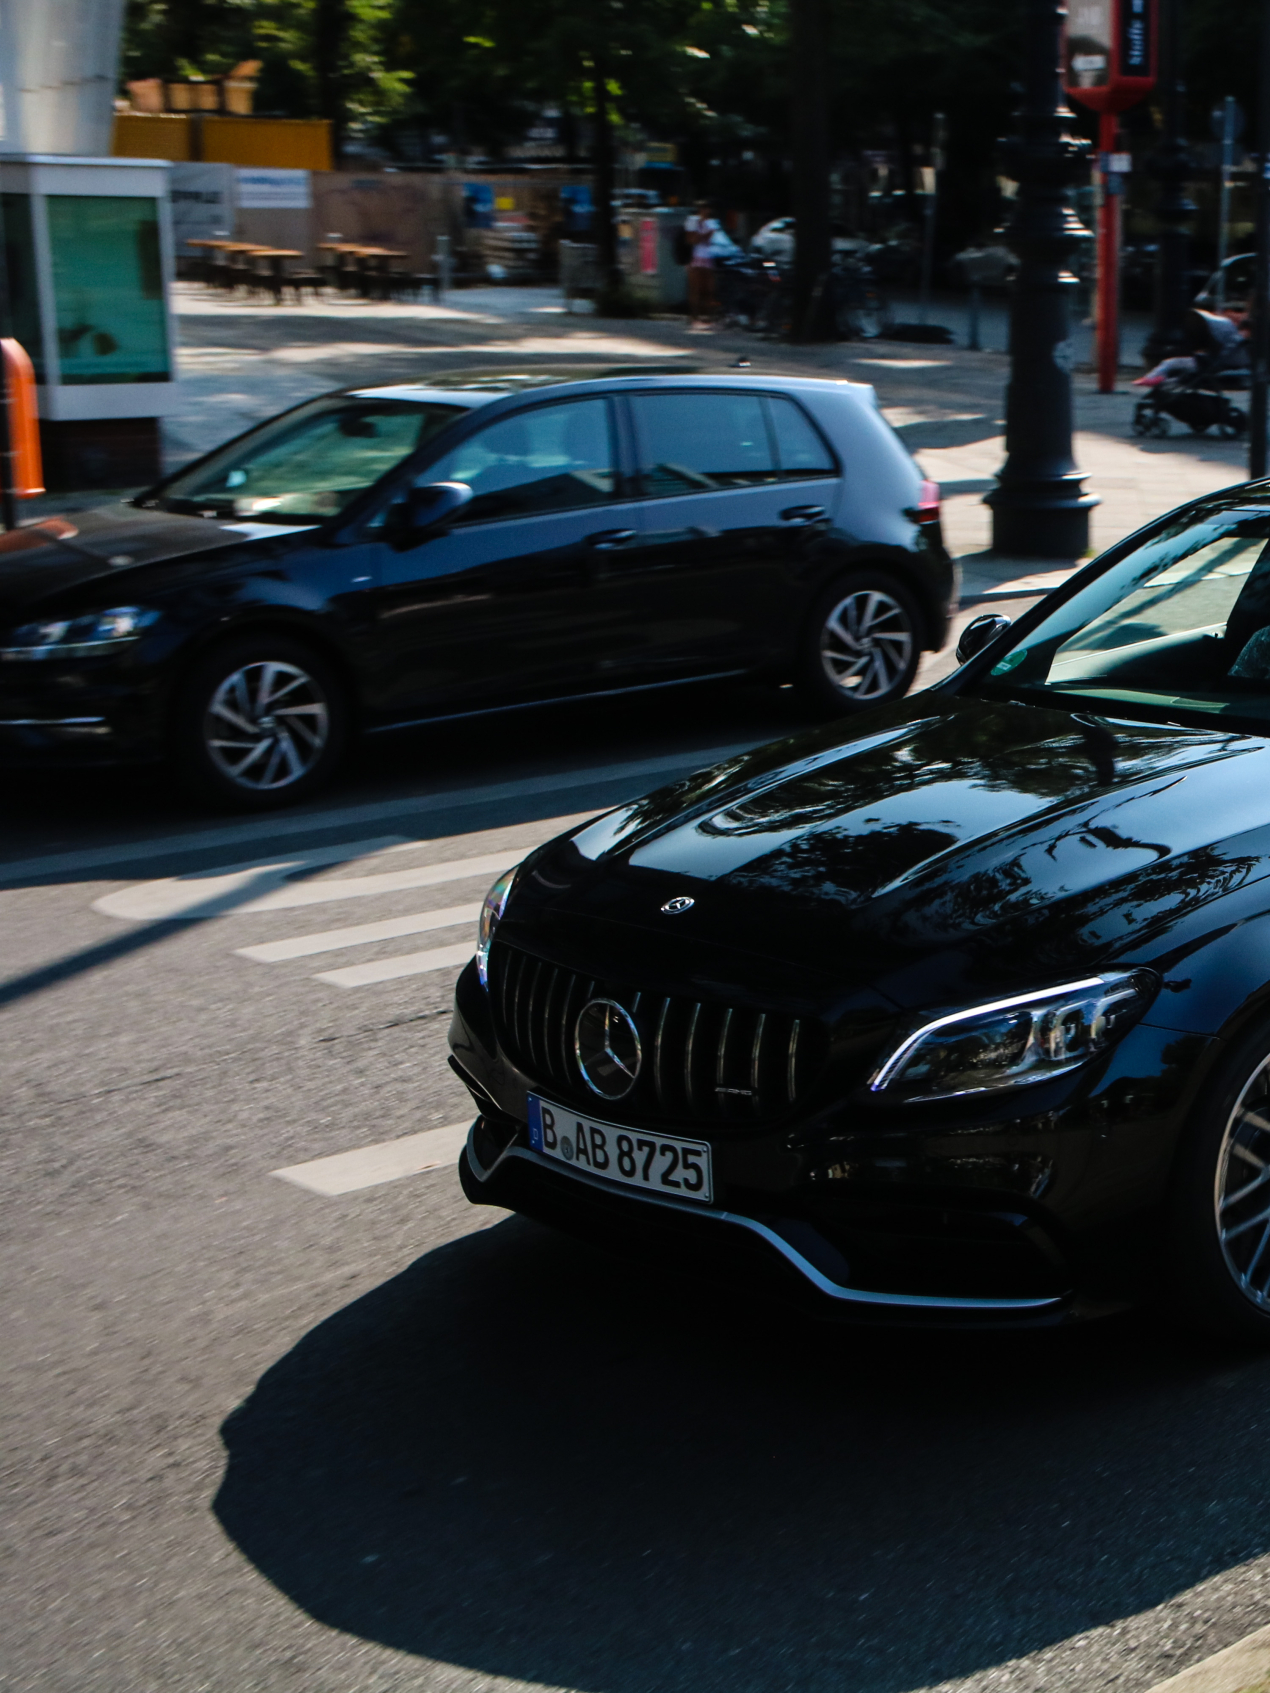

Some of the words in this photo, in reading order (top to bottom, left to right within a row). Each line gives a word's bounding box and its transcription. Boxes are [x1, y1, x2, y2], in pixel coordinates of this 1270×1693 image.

[541, 1106, 558, 1151] B
[575, 1121, 610, 1171] AB
[616, 1134, 704, 1192] 8725
